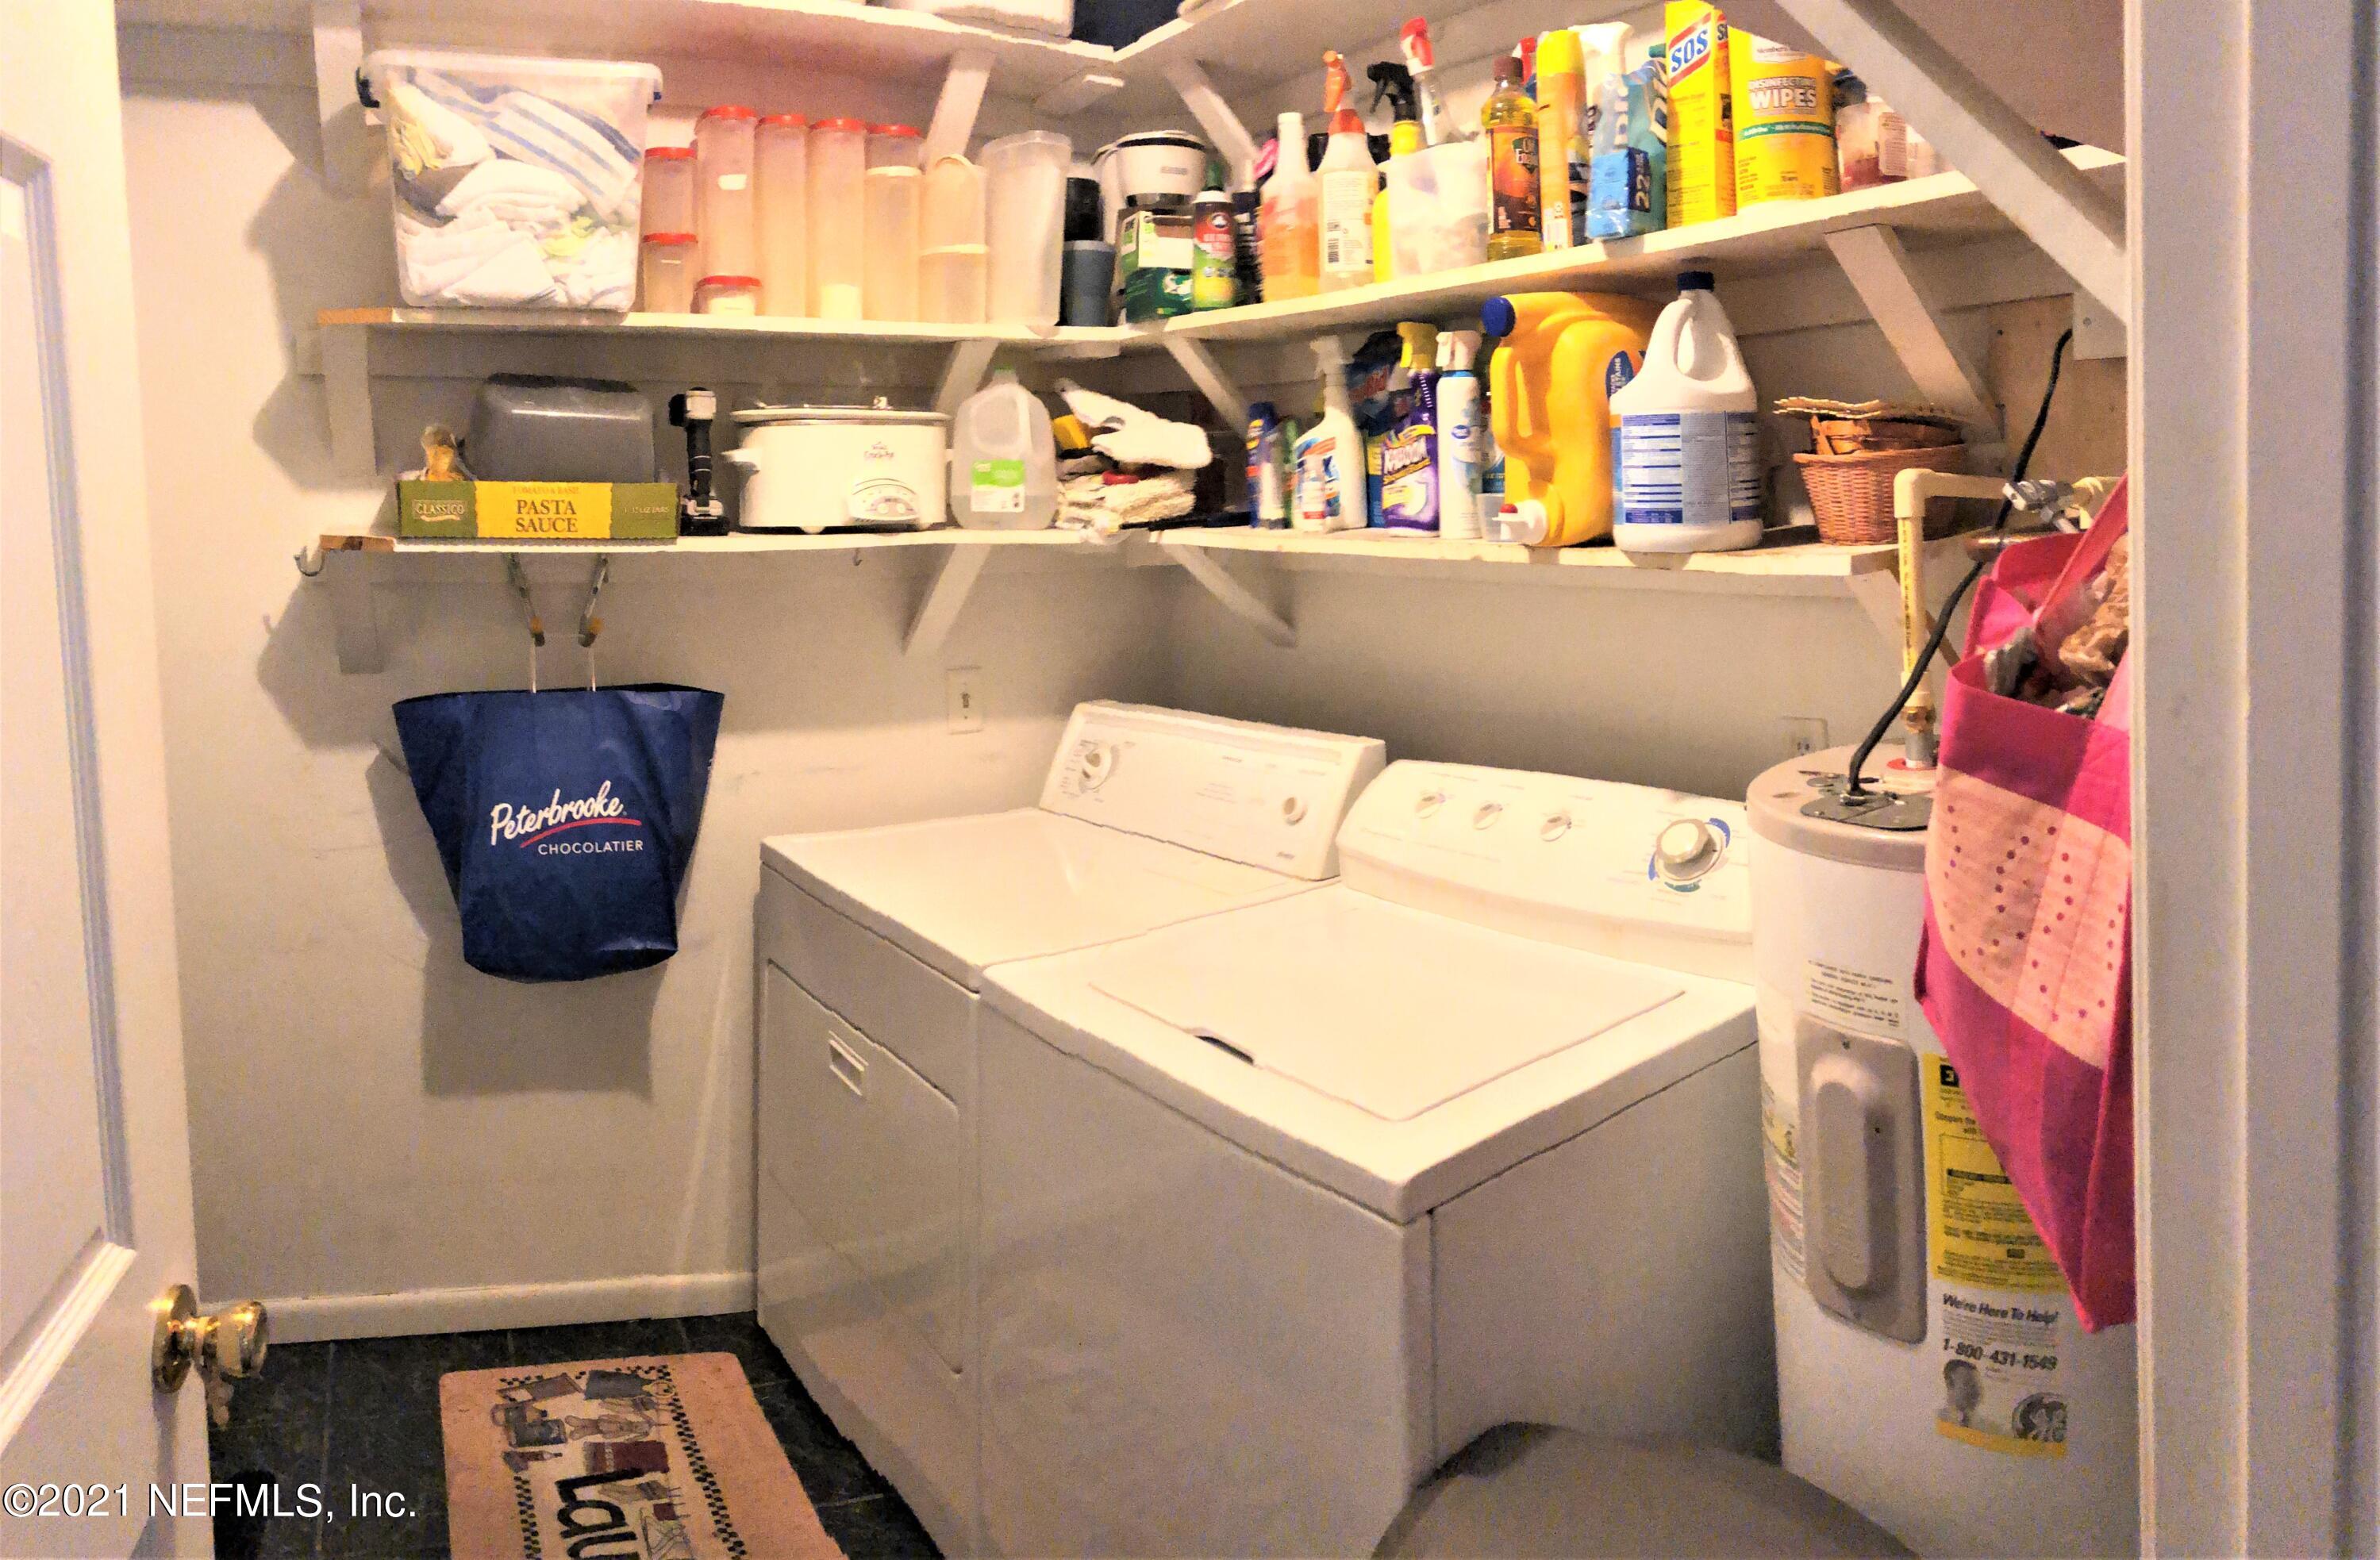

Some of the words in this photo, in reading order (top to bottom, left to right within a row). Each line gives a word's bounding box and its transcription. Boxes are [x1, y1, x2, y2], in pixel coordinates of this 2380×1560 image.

[1750, 88, 1817, 110] WIPES
[415, 503, 466, 515] CLASSICO
[516, 499, 577, 515] PASTA
[515, 517, 579, 533] SAUCE
[490, 779, 624, 847] Peterbrooke
[537, 840, 644, 856] CHOCOLATIER
[2011, 1307, 2024, 1320] To
